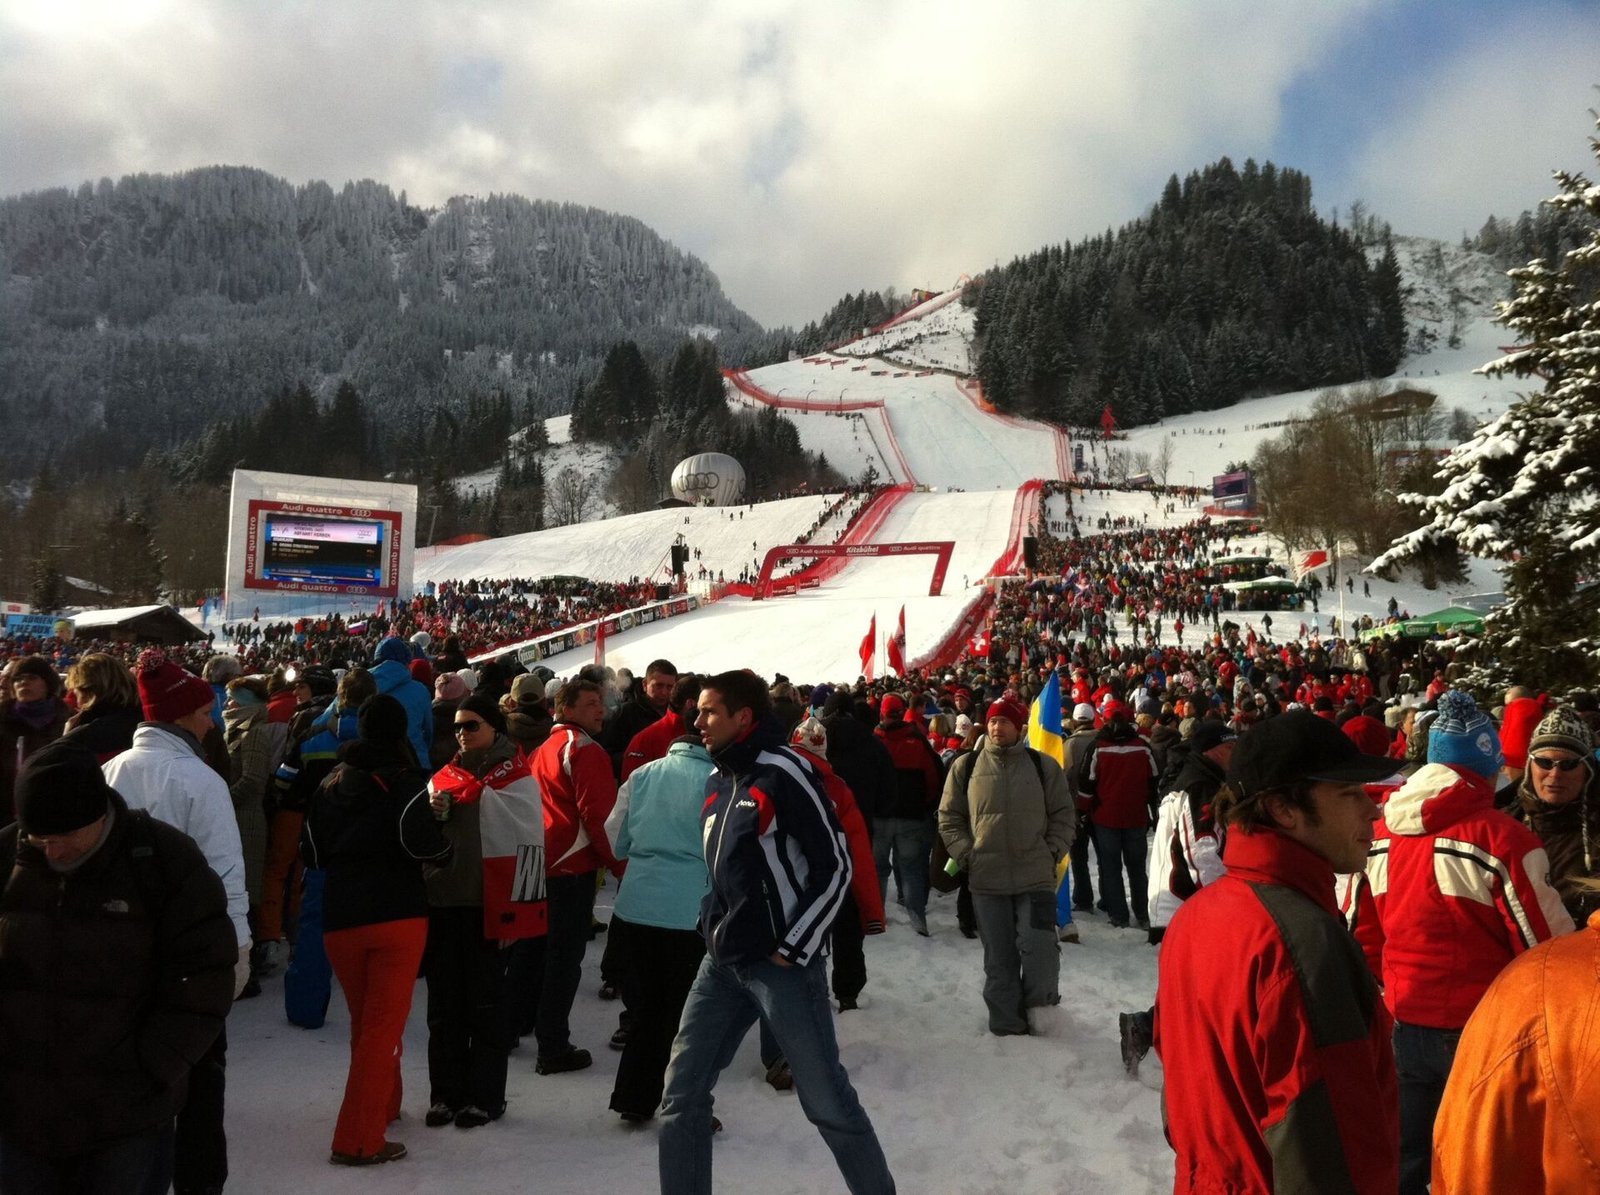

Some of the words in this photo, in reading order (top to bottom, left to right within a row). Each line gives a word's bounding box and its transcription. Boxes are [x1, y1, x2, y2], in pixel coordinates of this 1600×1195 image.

[281, 503, 303, 511] Audi
[306, 505, 343, 515] quattro
[392, 529, 400, 549] Audi
[846, 545, 879, 553] Kitzbühel
[246, 555, 254, 574] Audi
[390, 551, 398, 586] quattro
[276, 581, 300, 590] Audi
[302, 583, 338, 593] quattro
[549, 640, 565, 655] bwin
